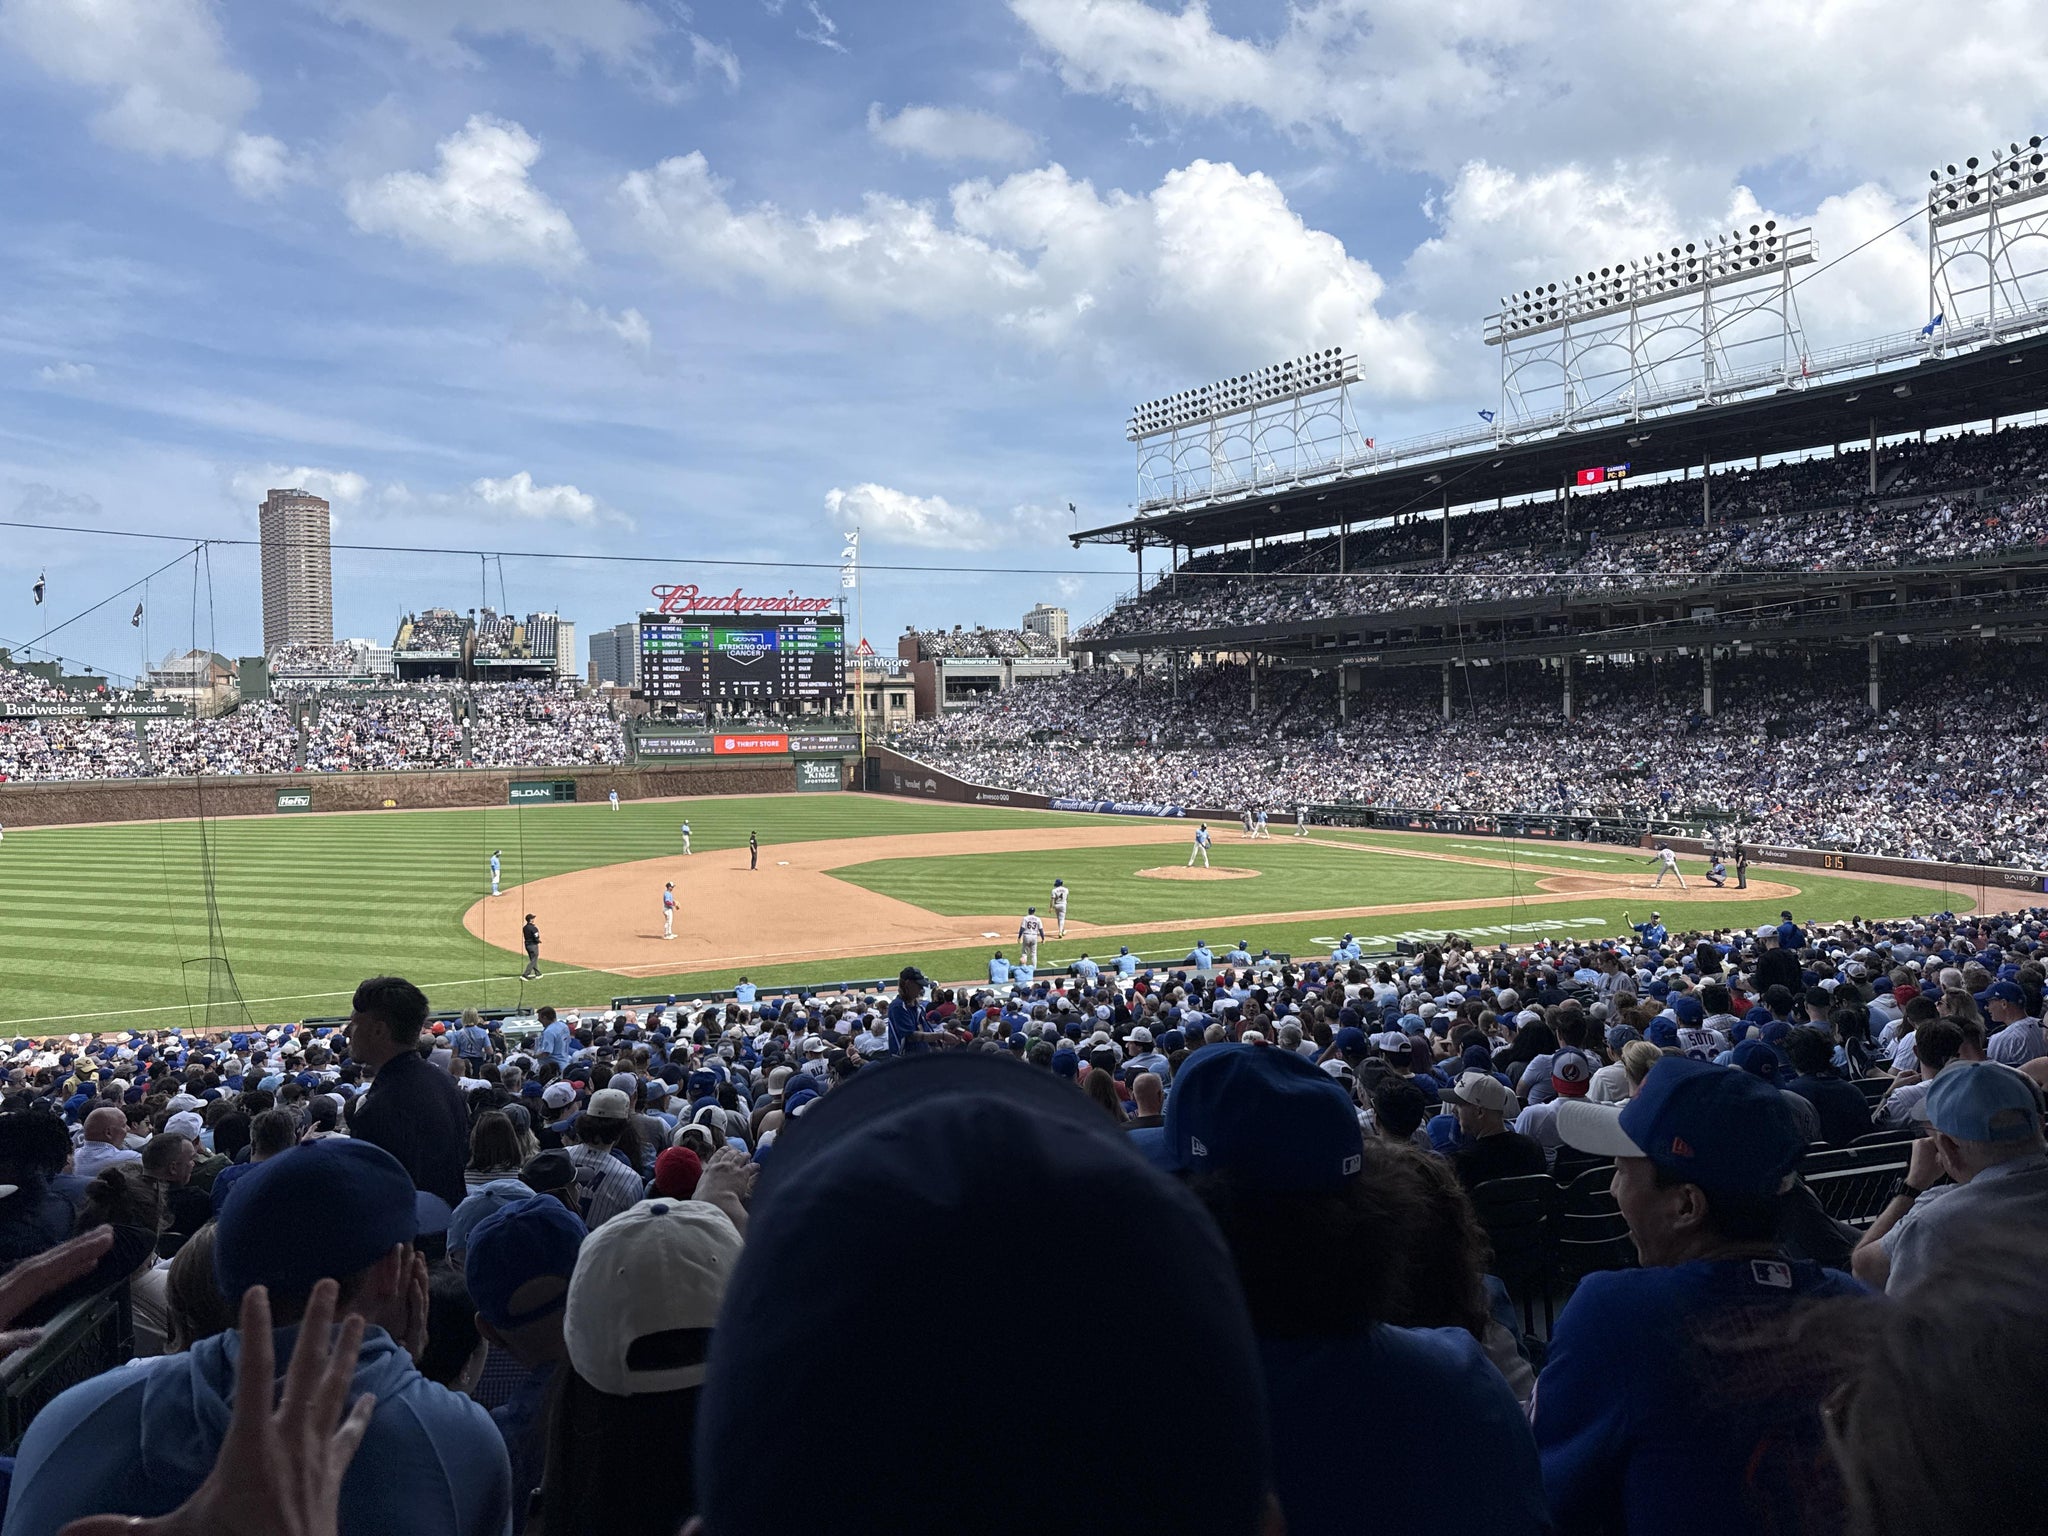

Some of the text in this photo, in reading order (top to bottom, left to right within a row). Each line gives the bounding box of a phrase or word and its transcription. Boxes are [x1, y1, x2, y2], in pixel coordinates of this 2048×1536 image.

[651, 584, 832, 613] Budweiser
[669, 616, 684, 624] Mets
[874, 658, 910, 667] Moore
[720, 687, 772, 695] 2 1 2 3
[117, 704, 168, 713] Advocate
[281, 796, 308, 805] Hefty
[1053, 801, 1095, 812] Reynolds Wrap
[1112, 803, 1162, 814] Reynolds Wrap
[1764, 850, 1788, 858] Advocate
[1027, 921, 1037, 930] 63
[1309, 917, 1584, 949] Southwest
[1688, 1032, 1715, 1046] SOTO
[810, 1066, 823, 1077] RIZ
